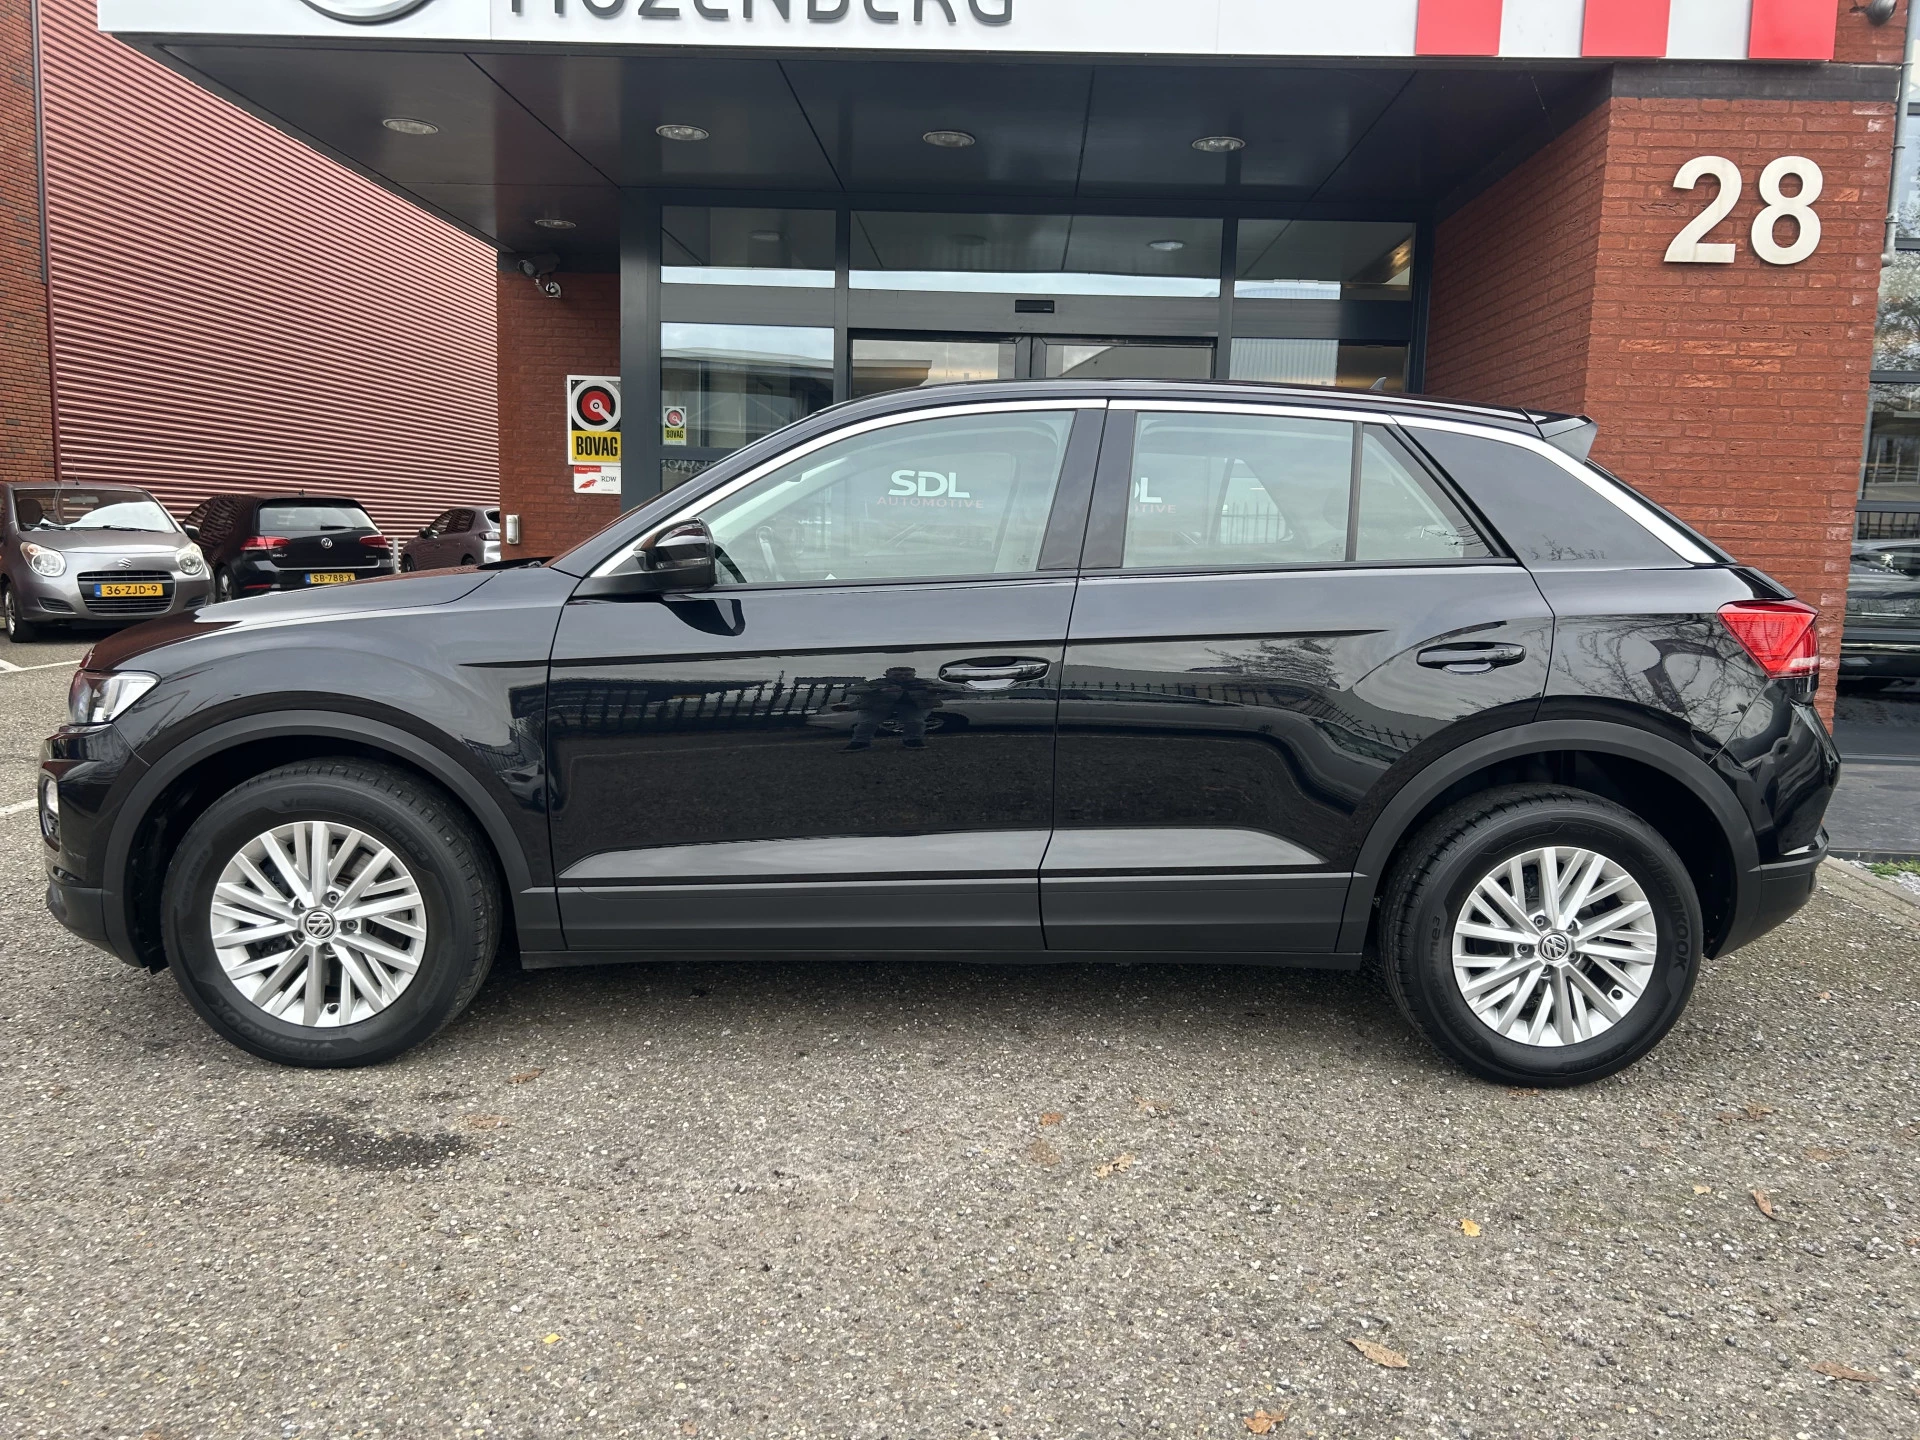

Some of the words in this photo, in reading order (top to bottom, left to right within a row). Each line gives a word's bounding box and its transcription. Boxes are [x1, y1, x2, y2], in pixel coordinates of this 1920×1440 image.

[1663, 155, 1824, 265] 28
[666, 429, 684, 439] BOVAG
[575, 435, 618, 457] BOVAG
[888, 469, 971, 499] SDL
[1134, 477, 1163, 504] L
[876, 495, 985, 510] AUTOMOTIVE
[313, 573, 353, 583] SB-788-X
[105, 584, 159, 597] 36-ZJD-9
